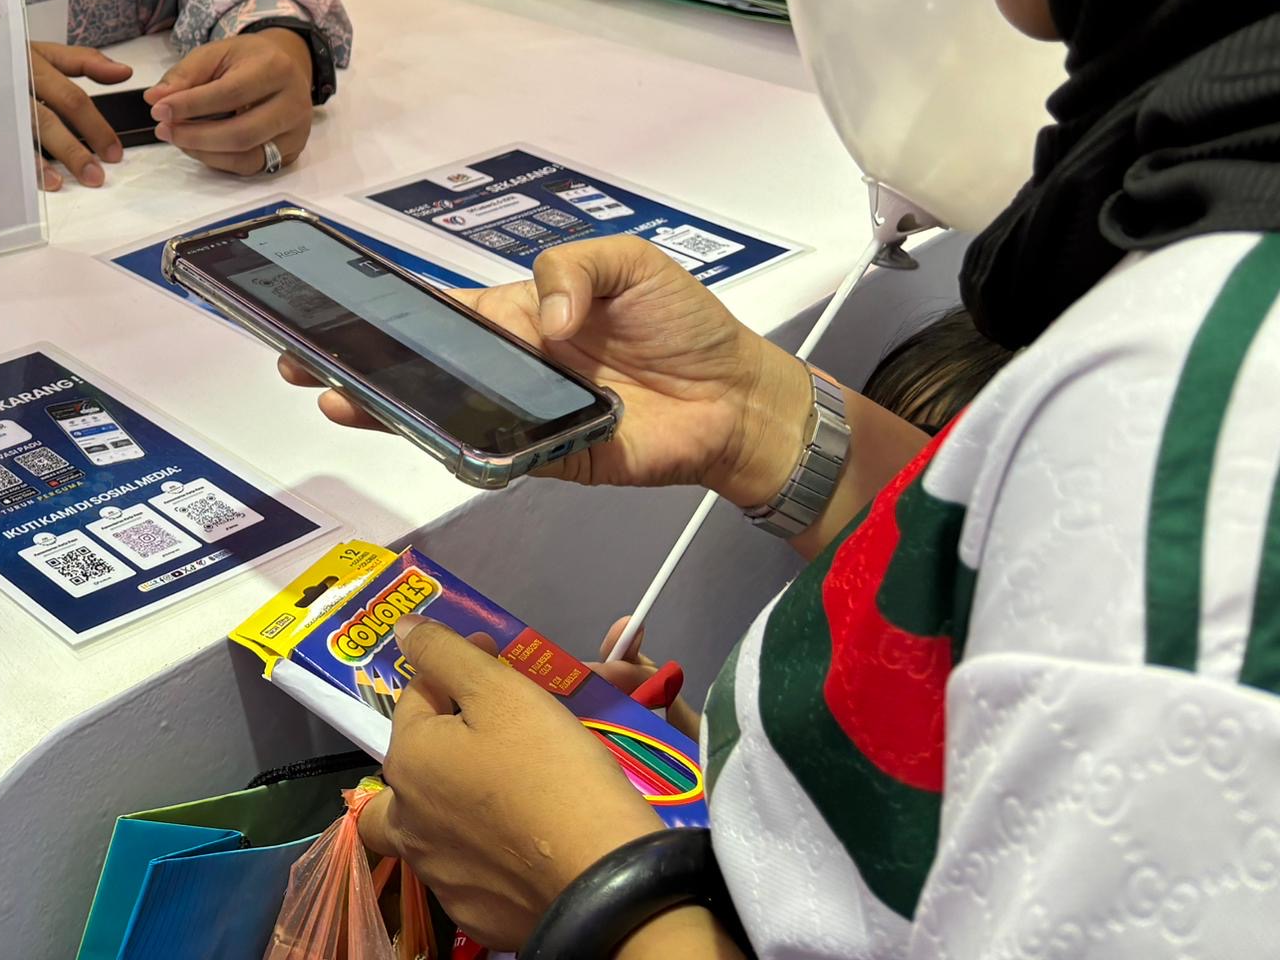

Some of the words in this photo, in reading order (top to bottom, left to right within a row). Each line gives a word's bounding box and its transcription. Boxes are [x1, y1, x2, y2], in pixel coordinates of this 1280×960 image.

[274, 245, 311, 260] Result
[18, 440, 43, 455] PADU
[0, 500, 35, 515] TURUN
[36, 480, 85, 502] PERCUMA
[2, 519, 43, 541] IKUTI
[38, 505, 80, 528] KAMI
[76, 500, 91, 513] DI
[88, 480, 139, 507] SOSIAL
[137, 464, 183, 489] MEDIA:
[339, 548, 362, 562] 12
[336, 574, 434, 659] COLORES
